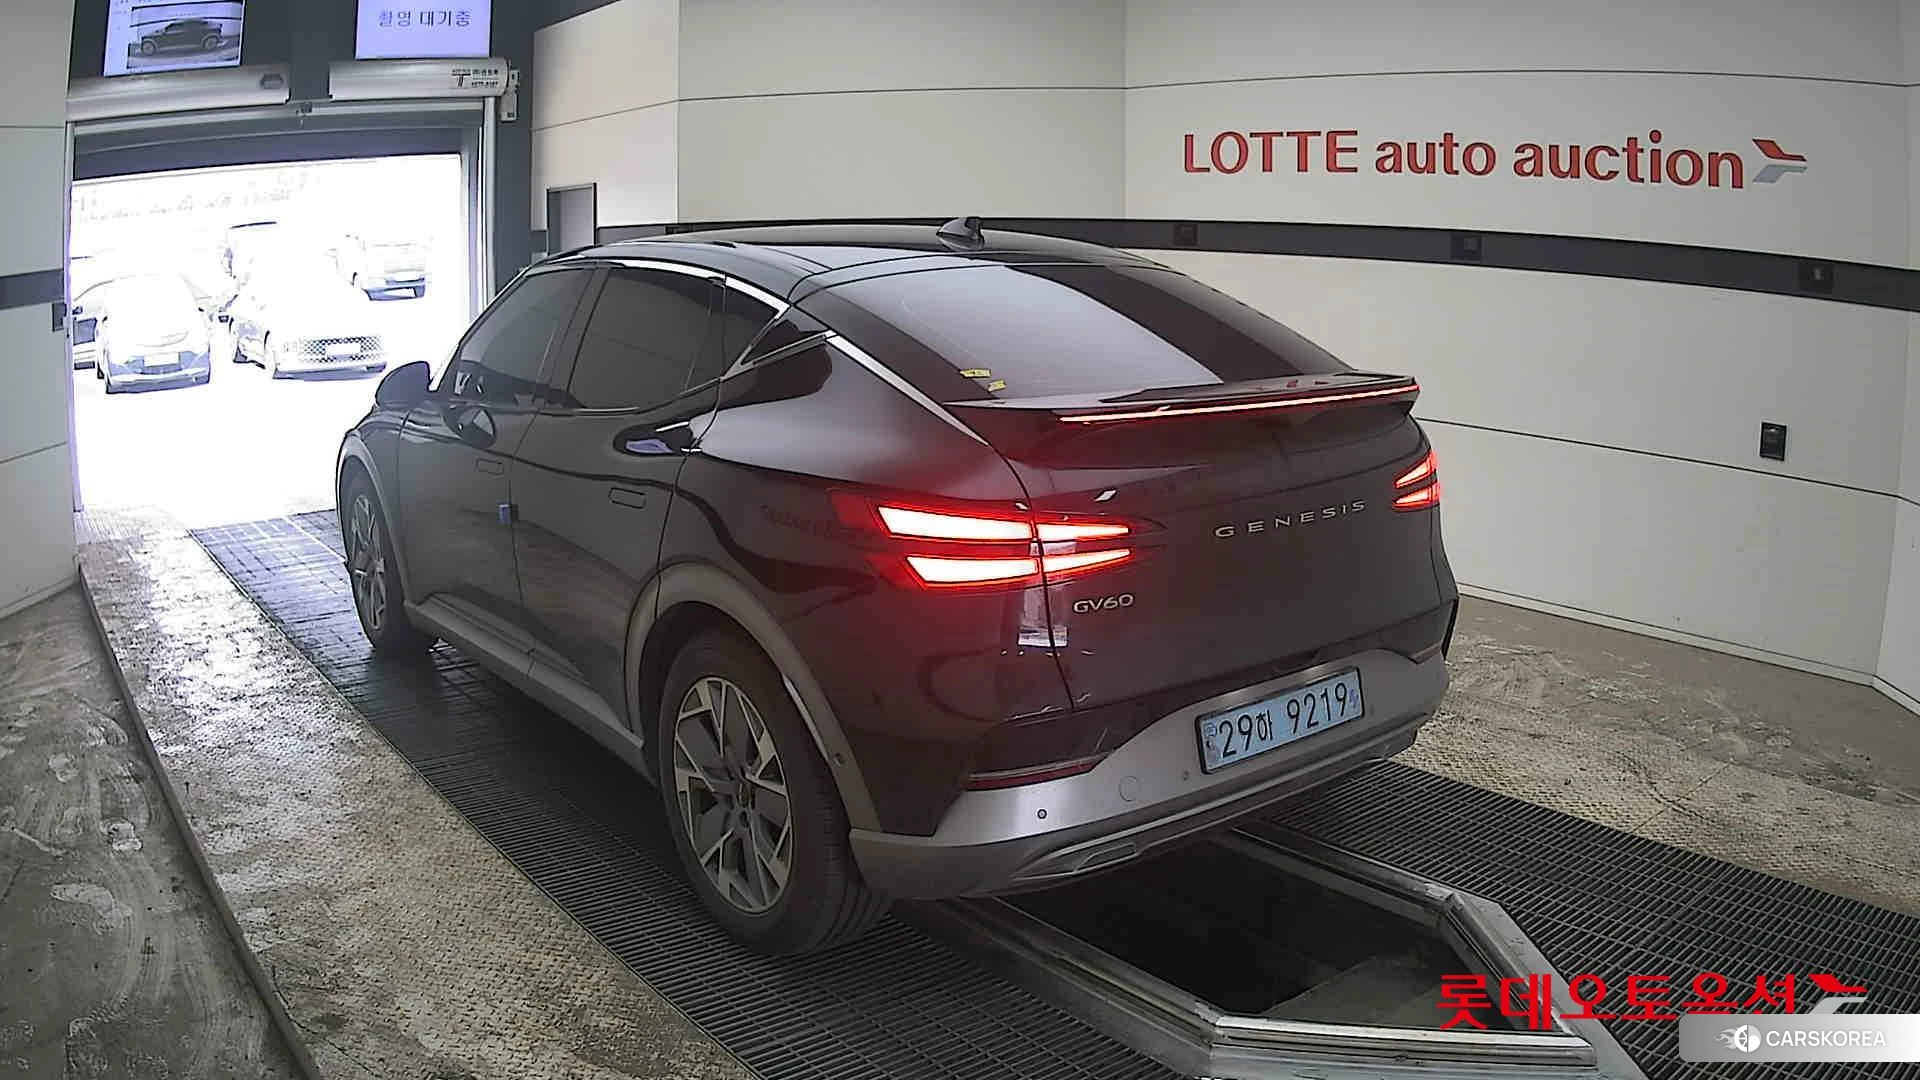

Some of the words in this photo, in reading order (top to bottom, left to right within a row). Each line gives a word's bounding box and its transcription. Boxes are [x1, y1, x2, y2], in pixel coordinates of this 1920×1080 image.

[419, 10, 472, 27] 대기중
[1184, 129, 1358, 174] LOTTE
[1375, 132, 1497, 176] auto
[1512, 129, 1744, 189] auction
[1215, 499, 1366, 538] GENESIS
[1073, 593, 1134, 613] GV60
[1219, 709, 1273, 759] 29하
[1286, 682, 1348, 734] 9219
